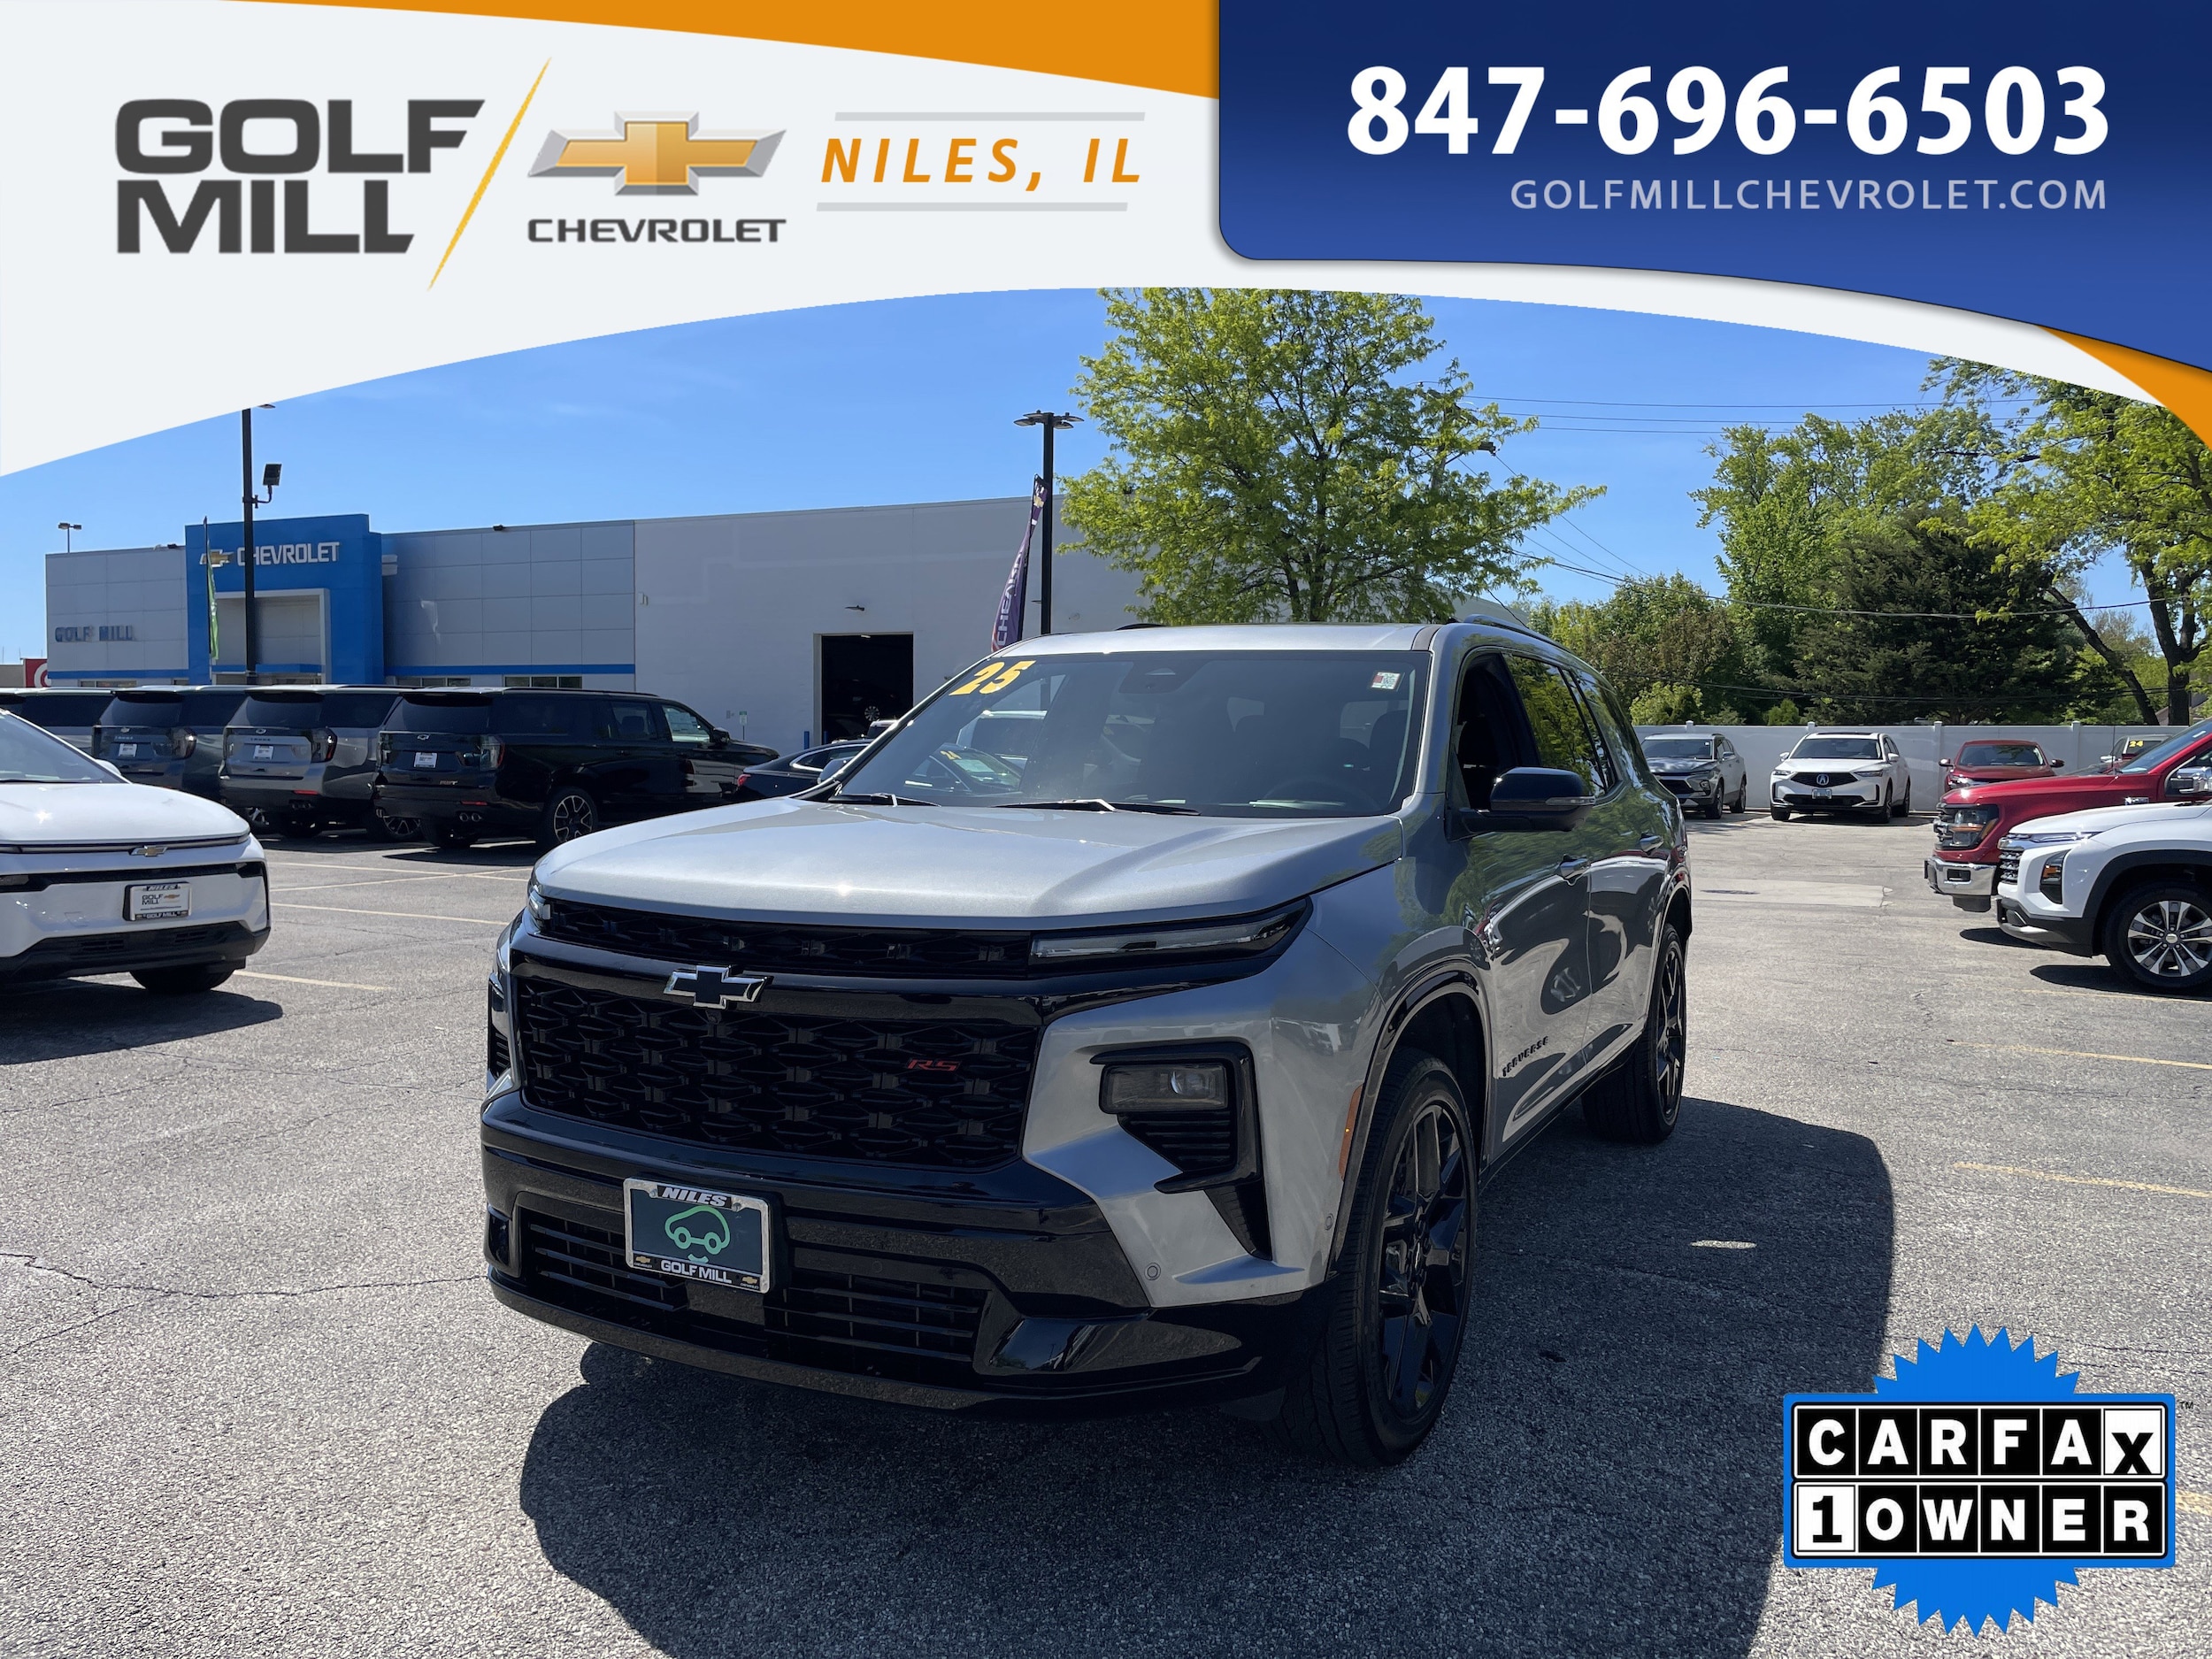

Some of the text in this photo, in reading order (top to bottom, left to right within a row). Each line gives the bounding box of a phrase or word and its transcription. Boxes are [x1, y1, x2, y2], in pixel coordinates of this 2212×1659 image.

[236, 541, 340, 566] CHEVROLET
[55, 626, 133, 642] GOLF MILL
[948, 660, 1036, 695] 25
[907, 1058, 960, 1071] RS
[662, 1187, 727, 1207] NILES
[660, 1259, 733, 1284] GOLF MILL
